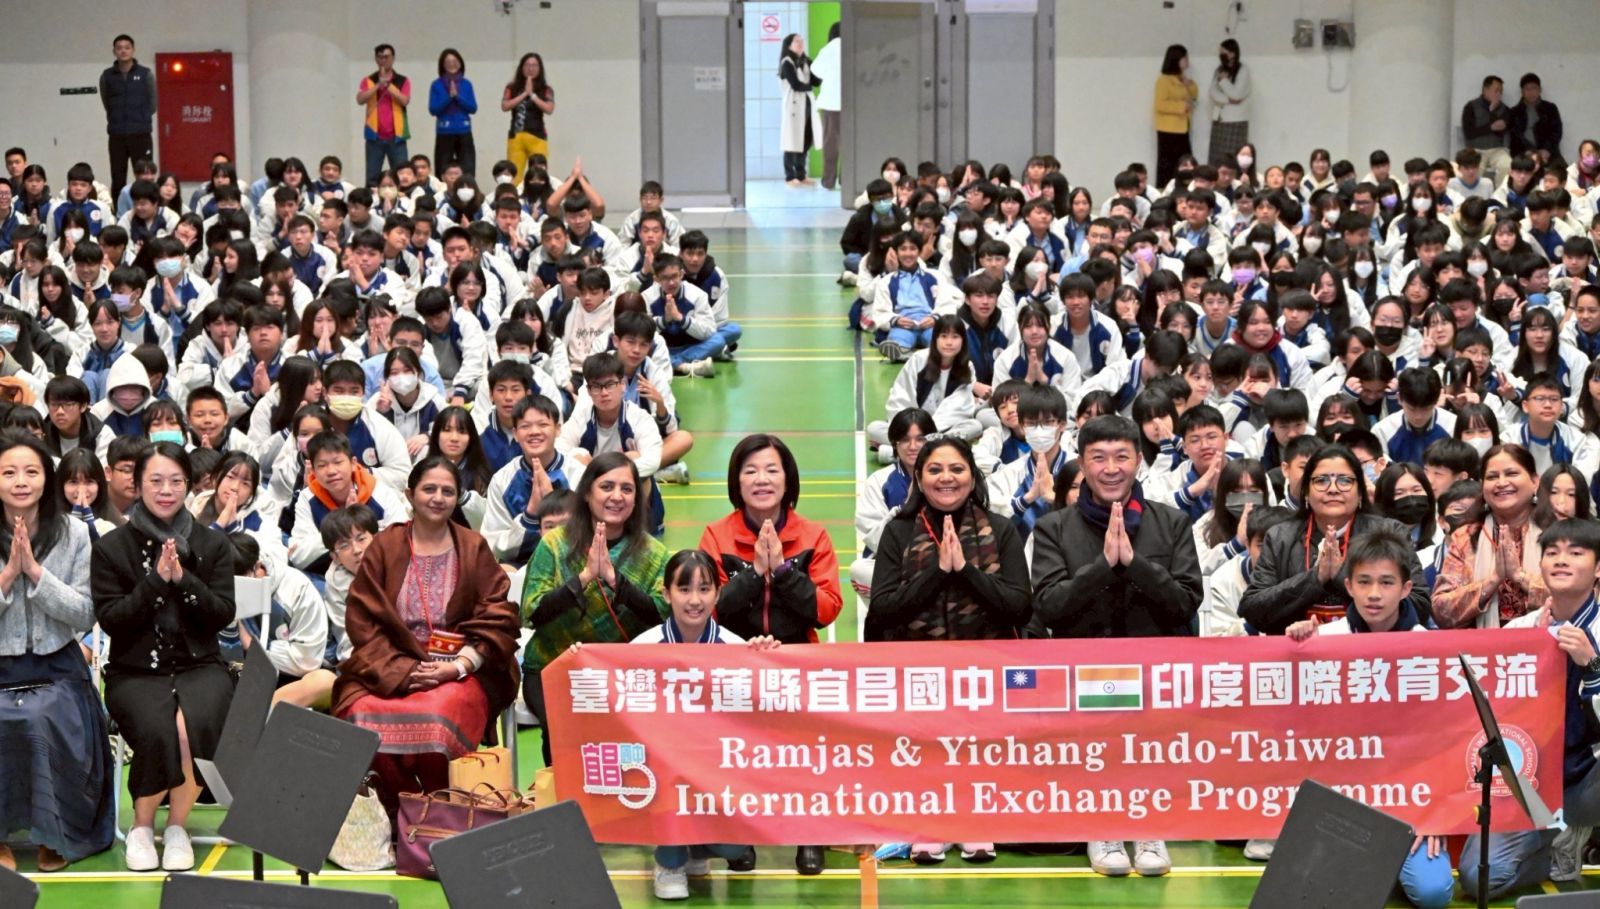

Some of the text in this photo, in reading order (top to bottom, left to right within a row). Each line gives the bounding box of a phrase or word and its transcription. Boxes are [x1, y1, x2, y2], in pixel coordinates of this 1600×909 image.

[568, 666, 995, 713] 臺灣花蓮縣宜昌國中
[1151, 653, 1538, 709] 印度國際教育交流
[719, 729, 1385, 775] Ramjas & Yichang Indo-Taiwan
[675, 779, 1431, 819] International Exchange Progrmme
